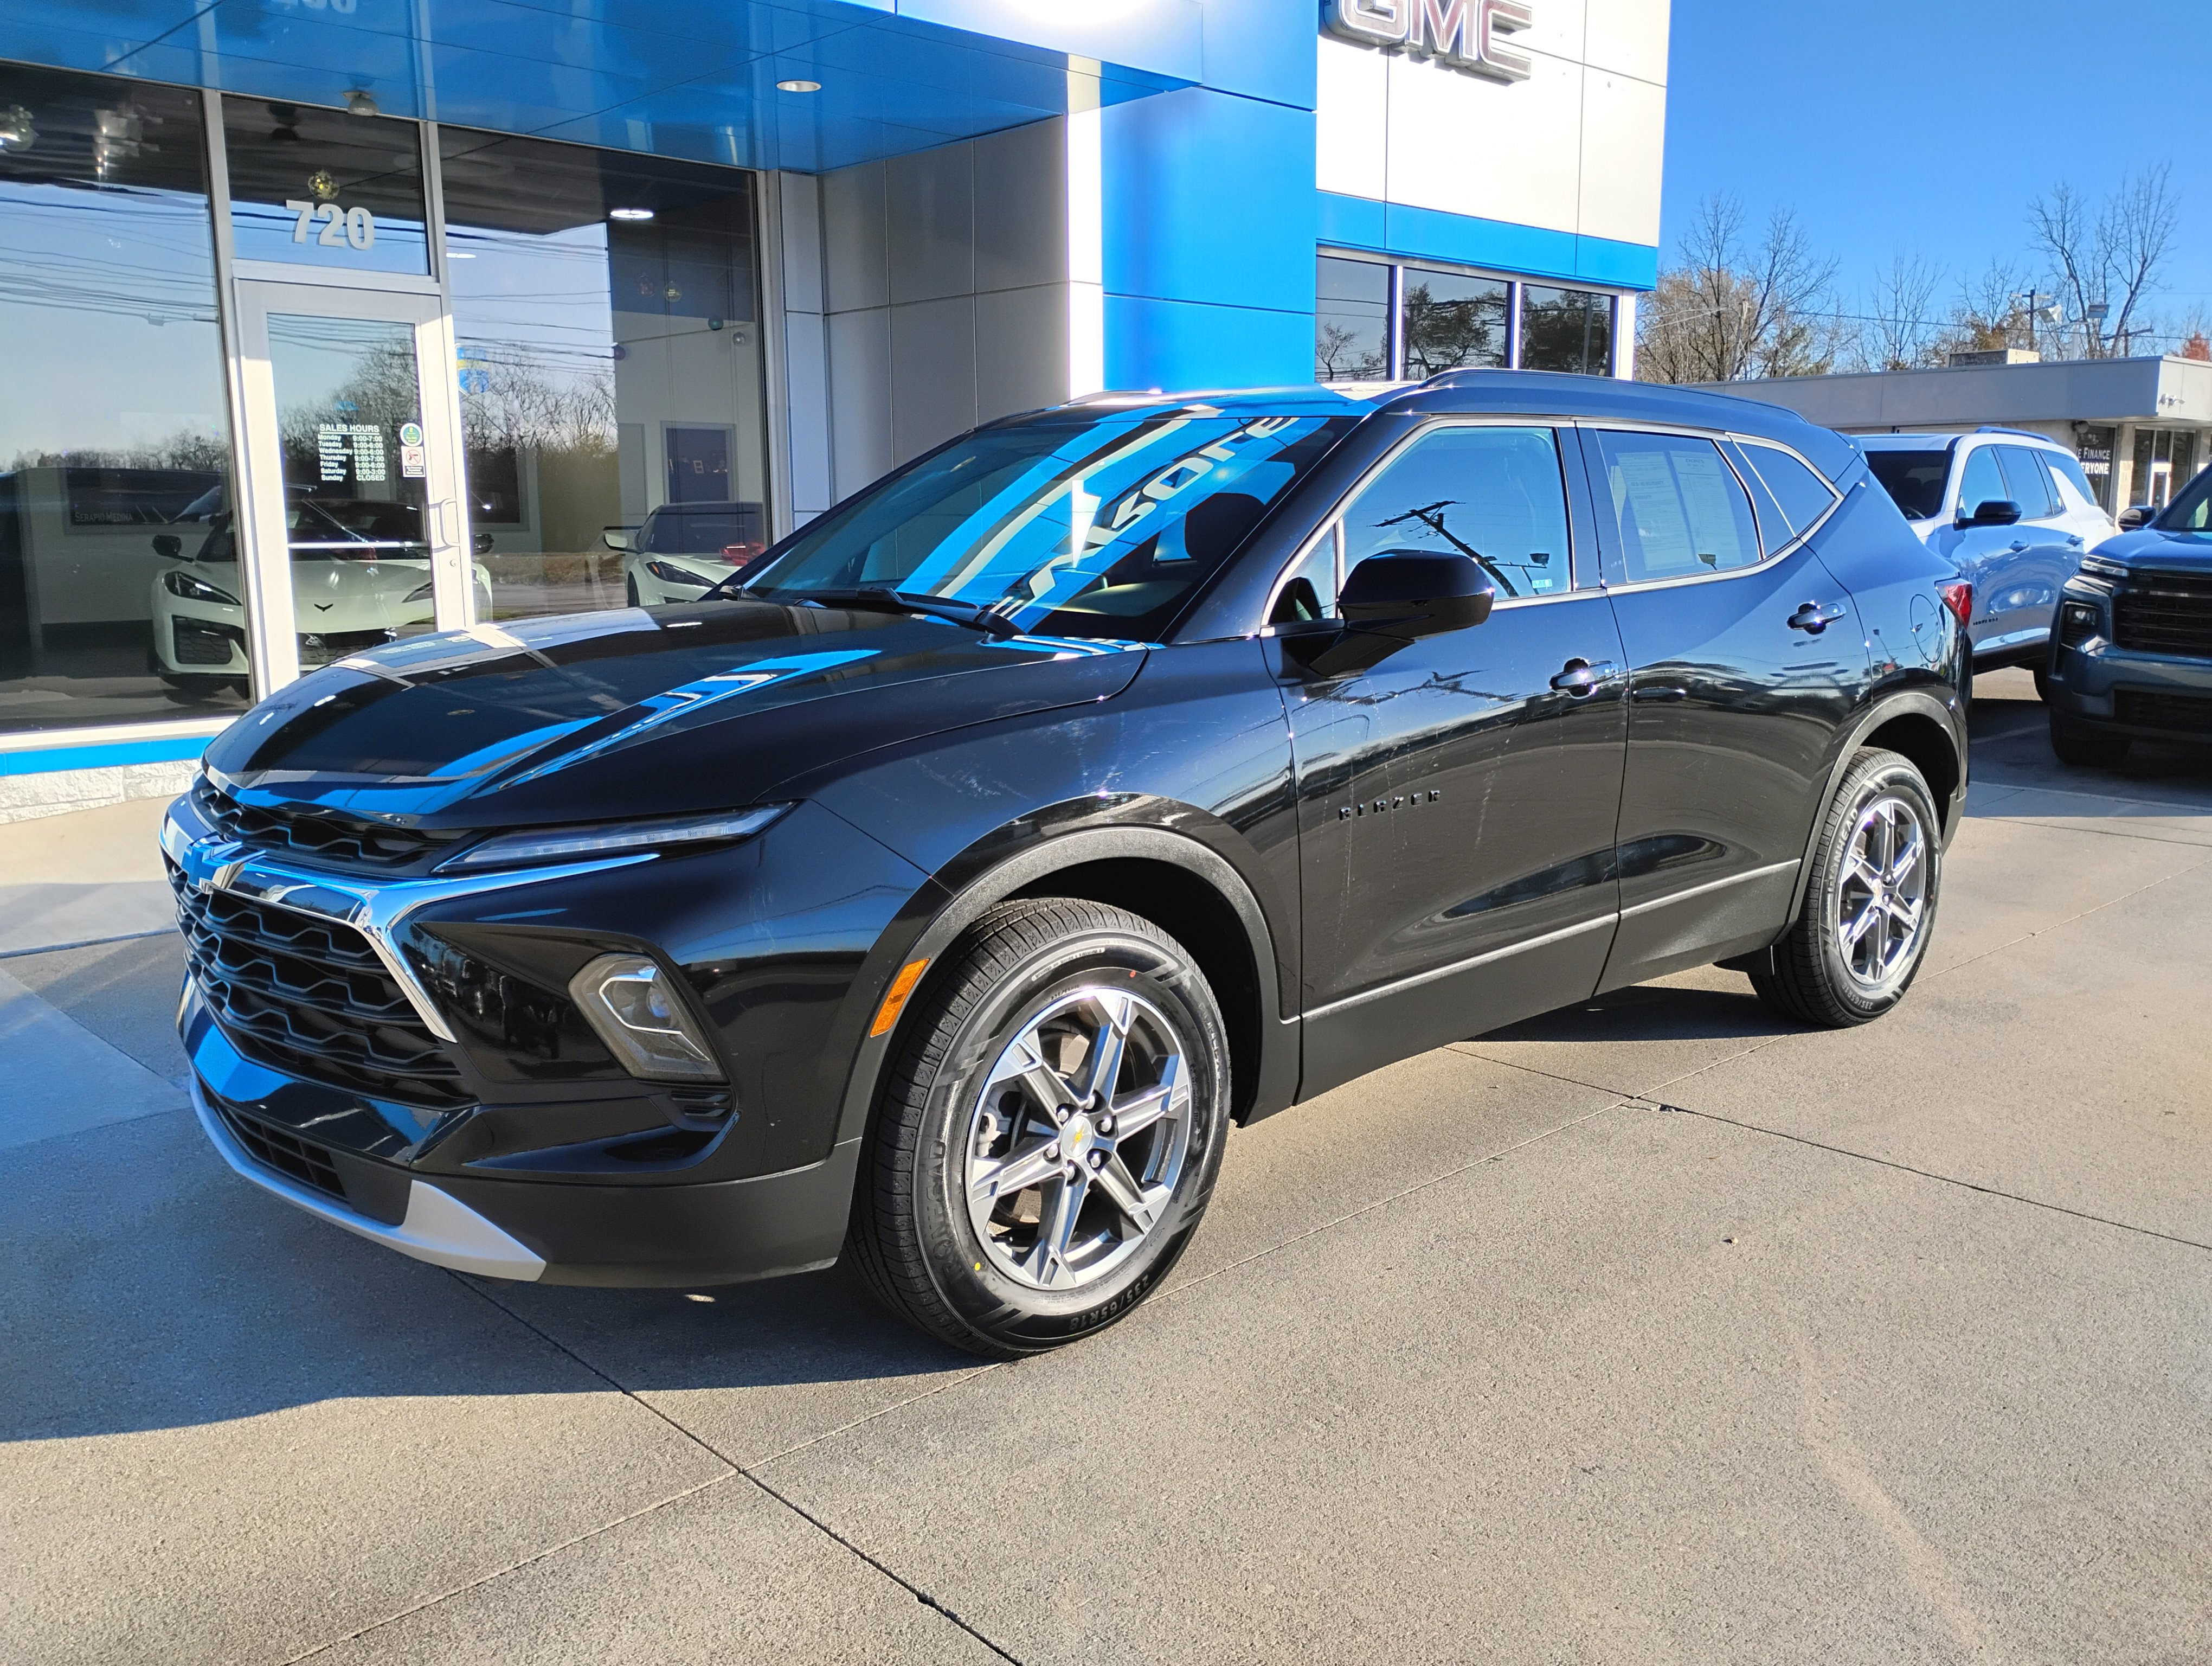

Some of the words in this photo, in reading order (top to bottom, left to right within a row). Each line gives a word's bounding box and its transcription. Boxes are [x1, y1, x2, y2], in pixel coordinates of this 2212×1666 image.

[1337, 0, 1532, 80] GMC
[286, 200, 375, 251] 720
[319, 424, 348, 432] SALES
[349, 424, 380, 432] HOURS
[2075, 447, 2082, 459] E
[2084, 447, 2111, 460] FINANCE
[2080, 462, 2110, 475] ERYONE
[106, 512, 133, 522] MEDINA
[1338, 790, 1441, 821] BLAZER
[1069, 1274, 1149, 1331] 235/65R18
